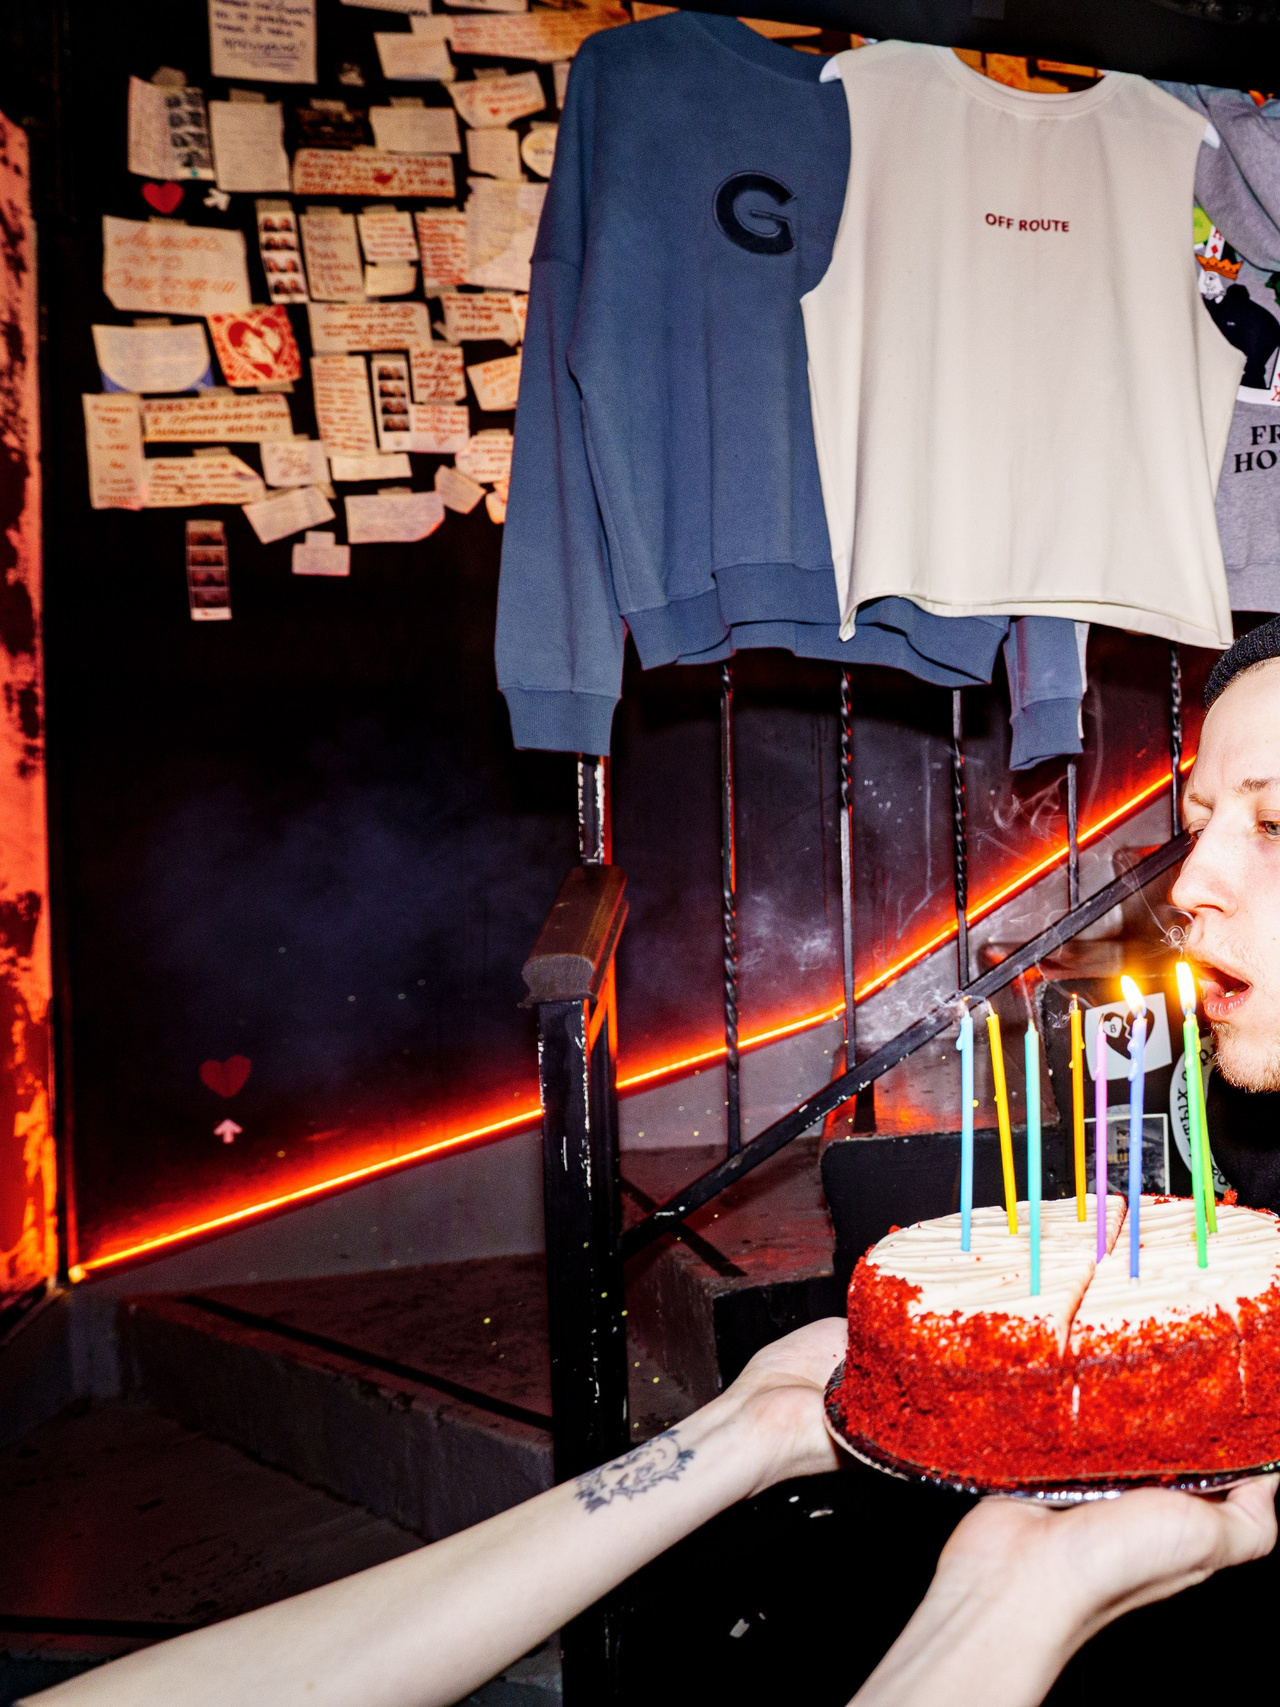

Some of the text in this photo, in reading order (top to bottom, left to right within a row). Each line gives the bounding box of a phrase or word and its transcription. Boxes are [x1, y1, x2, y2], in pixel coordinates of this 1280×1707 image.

[712, 170, 797, 255] G
[985, 212, 1070, 232] OFF ROUTE
